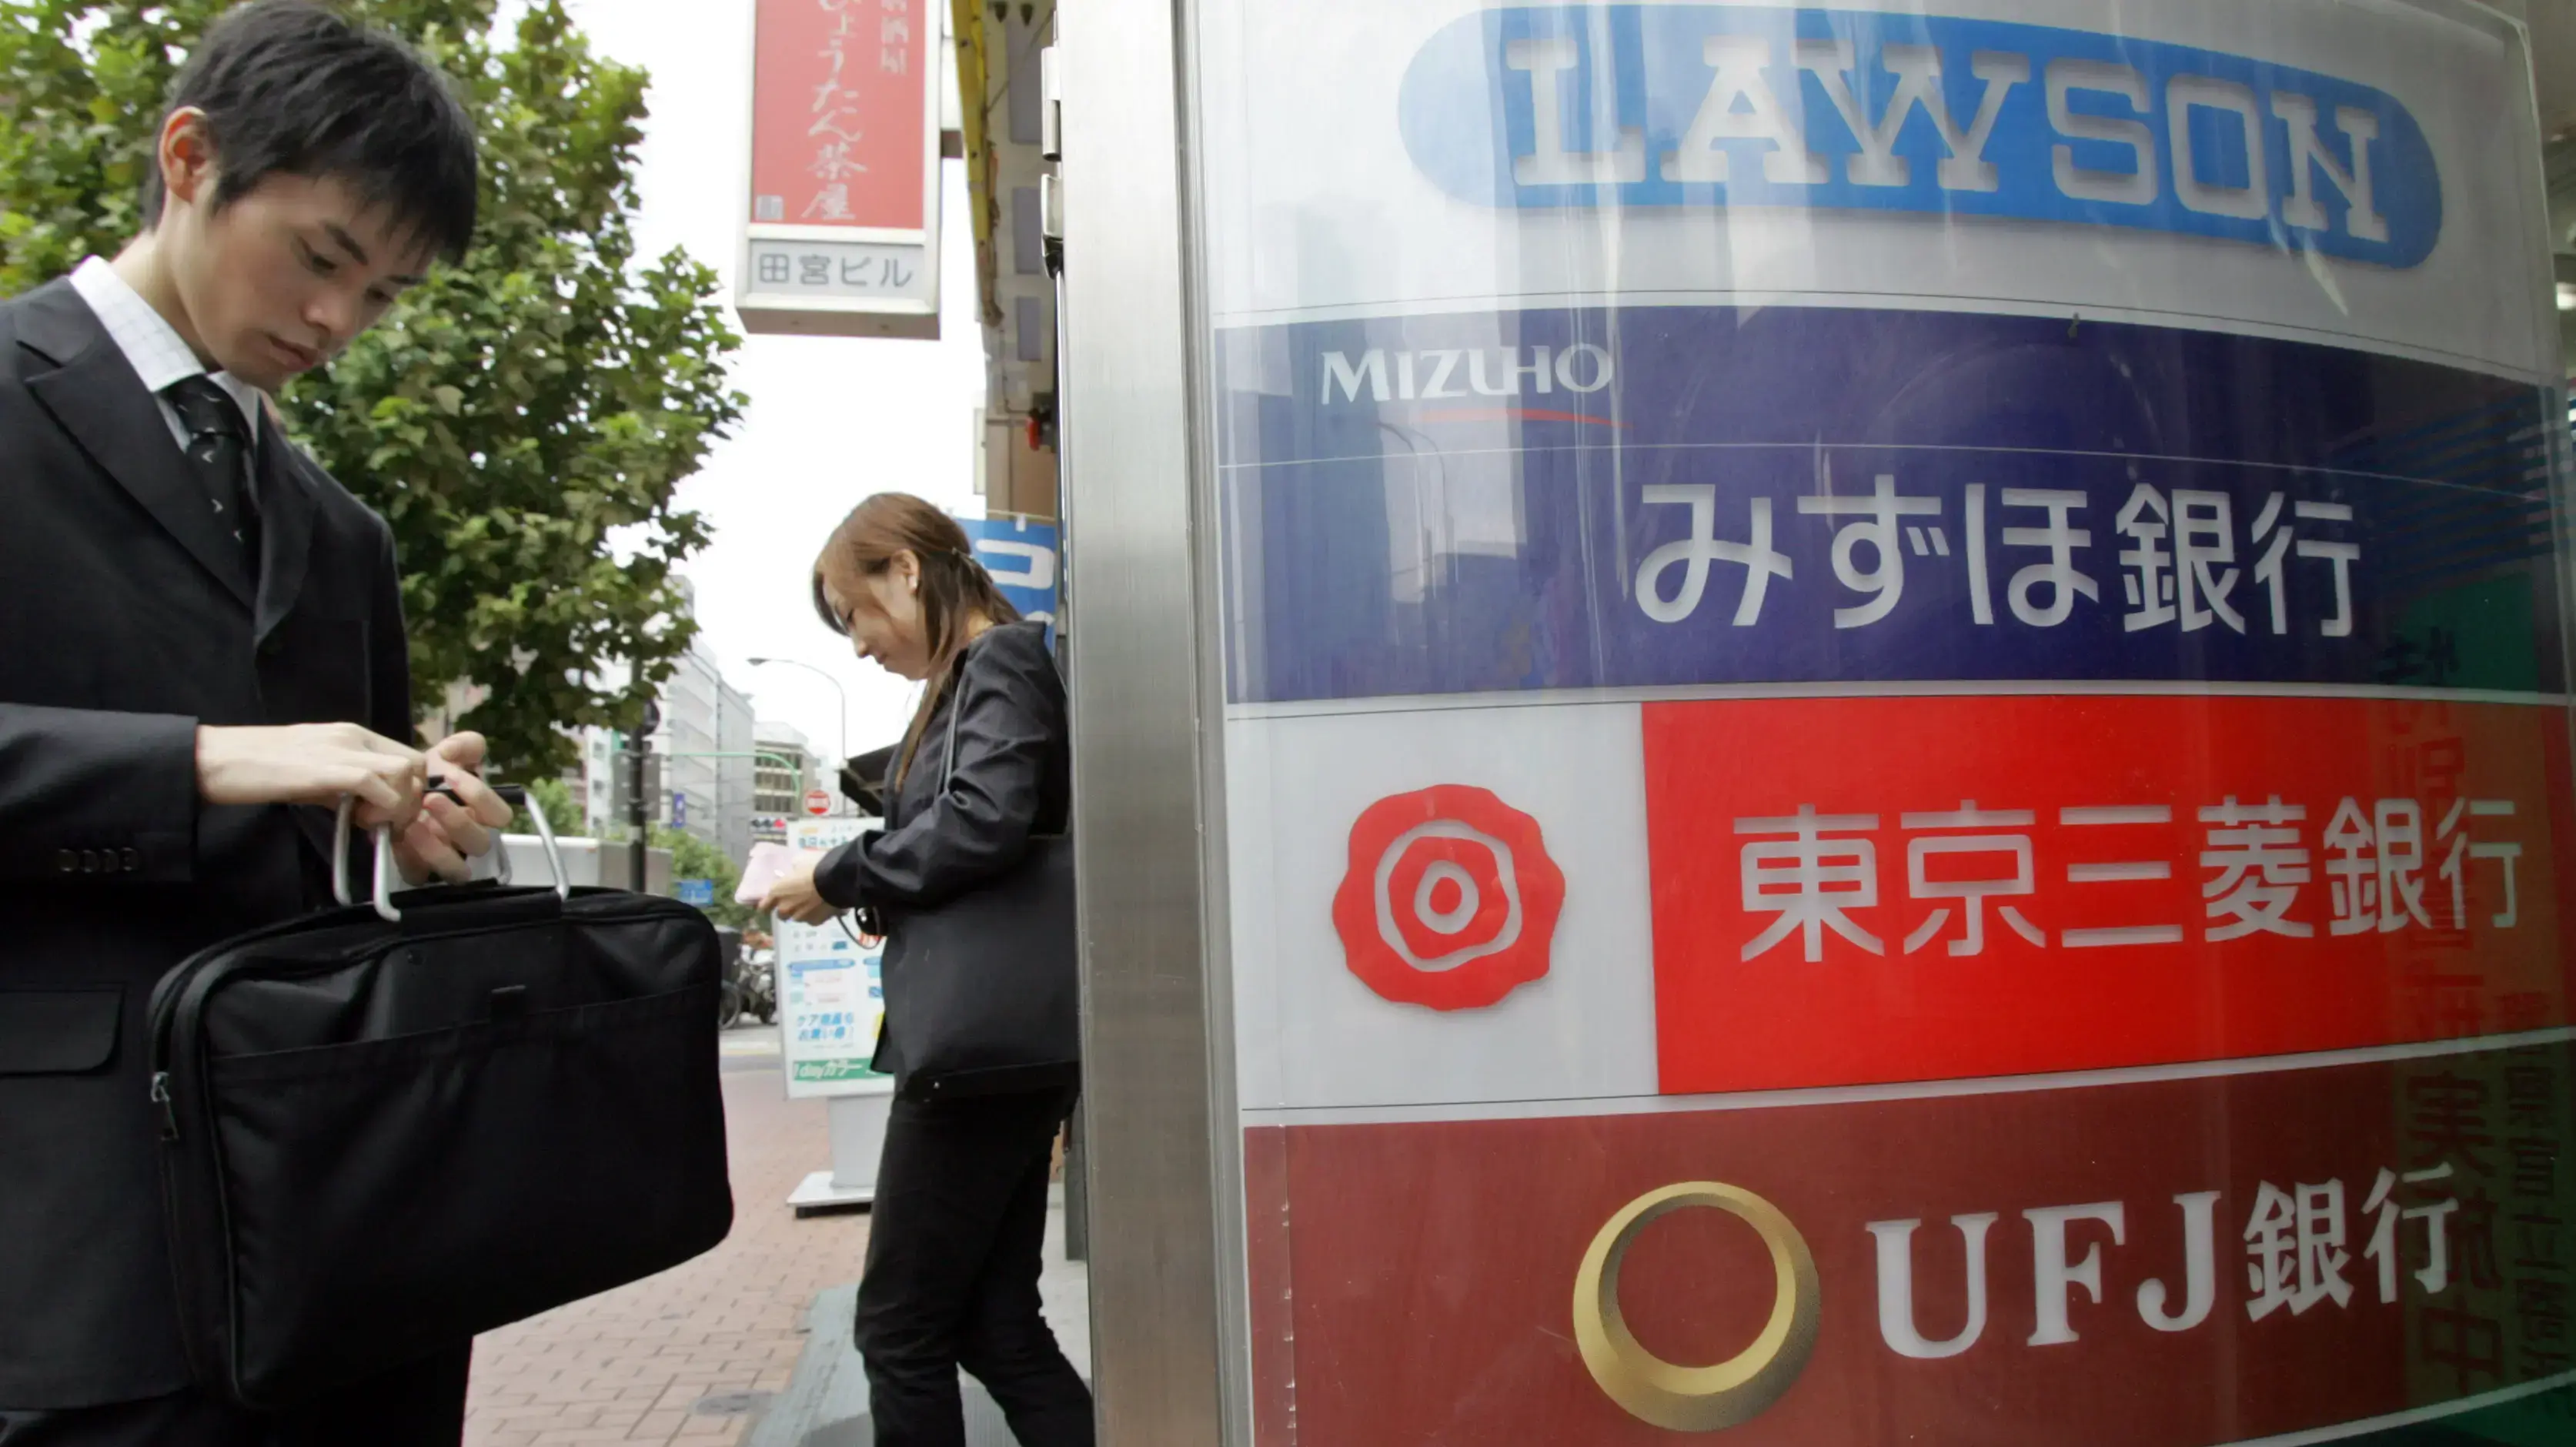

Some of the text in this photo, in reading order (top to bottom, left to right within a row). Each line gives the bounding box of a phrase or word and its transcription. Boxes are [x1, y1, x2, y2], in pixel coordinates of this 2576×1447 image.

[1506, 35, 2389, 242] LAWSON
[759, 253, 913, 288] 田宮ビル
[1321, 343, 1613, 405] MIZUHO
[1635, 474, 2360, 637] みずほ銀行
[1733, 794, 2523, 964] 東京三菱銀行
[1866, 1162, 2460, 1360] UFJ銀行
